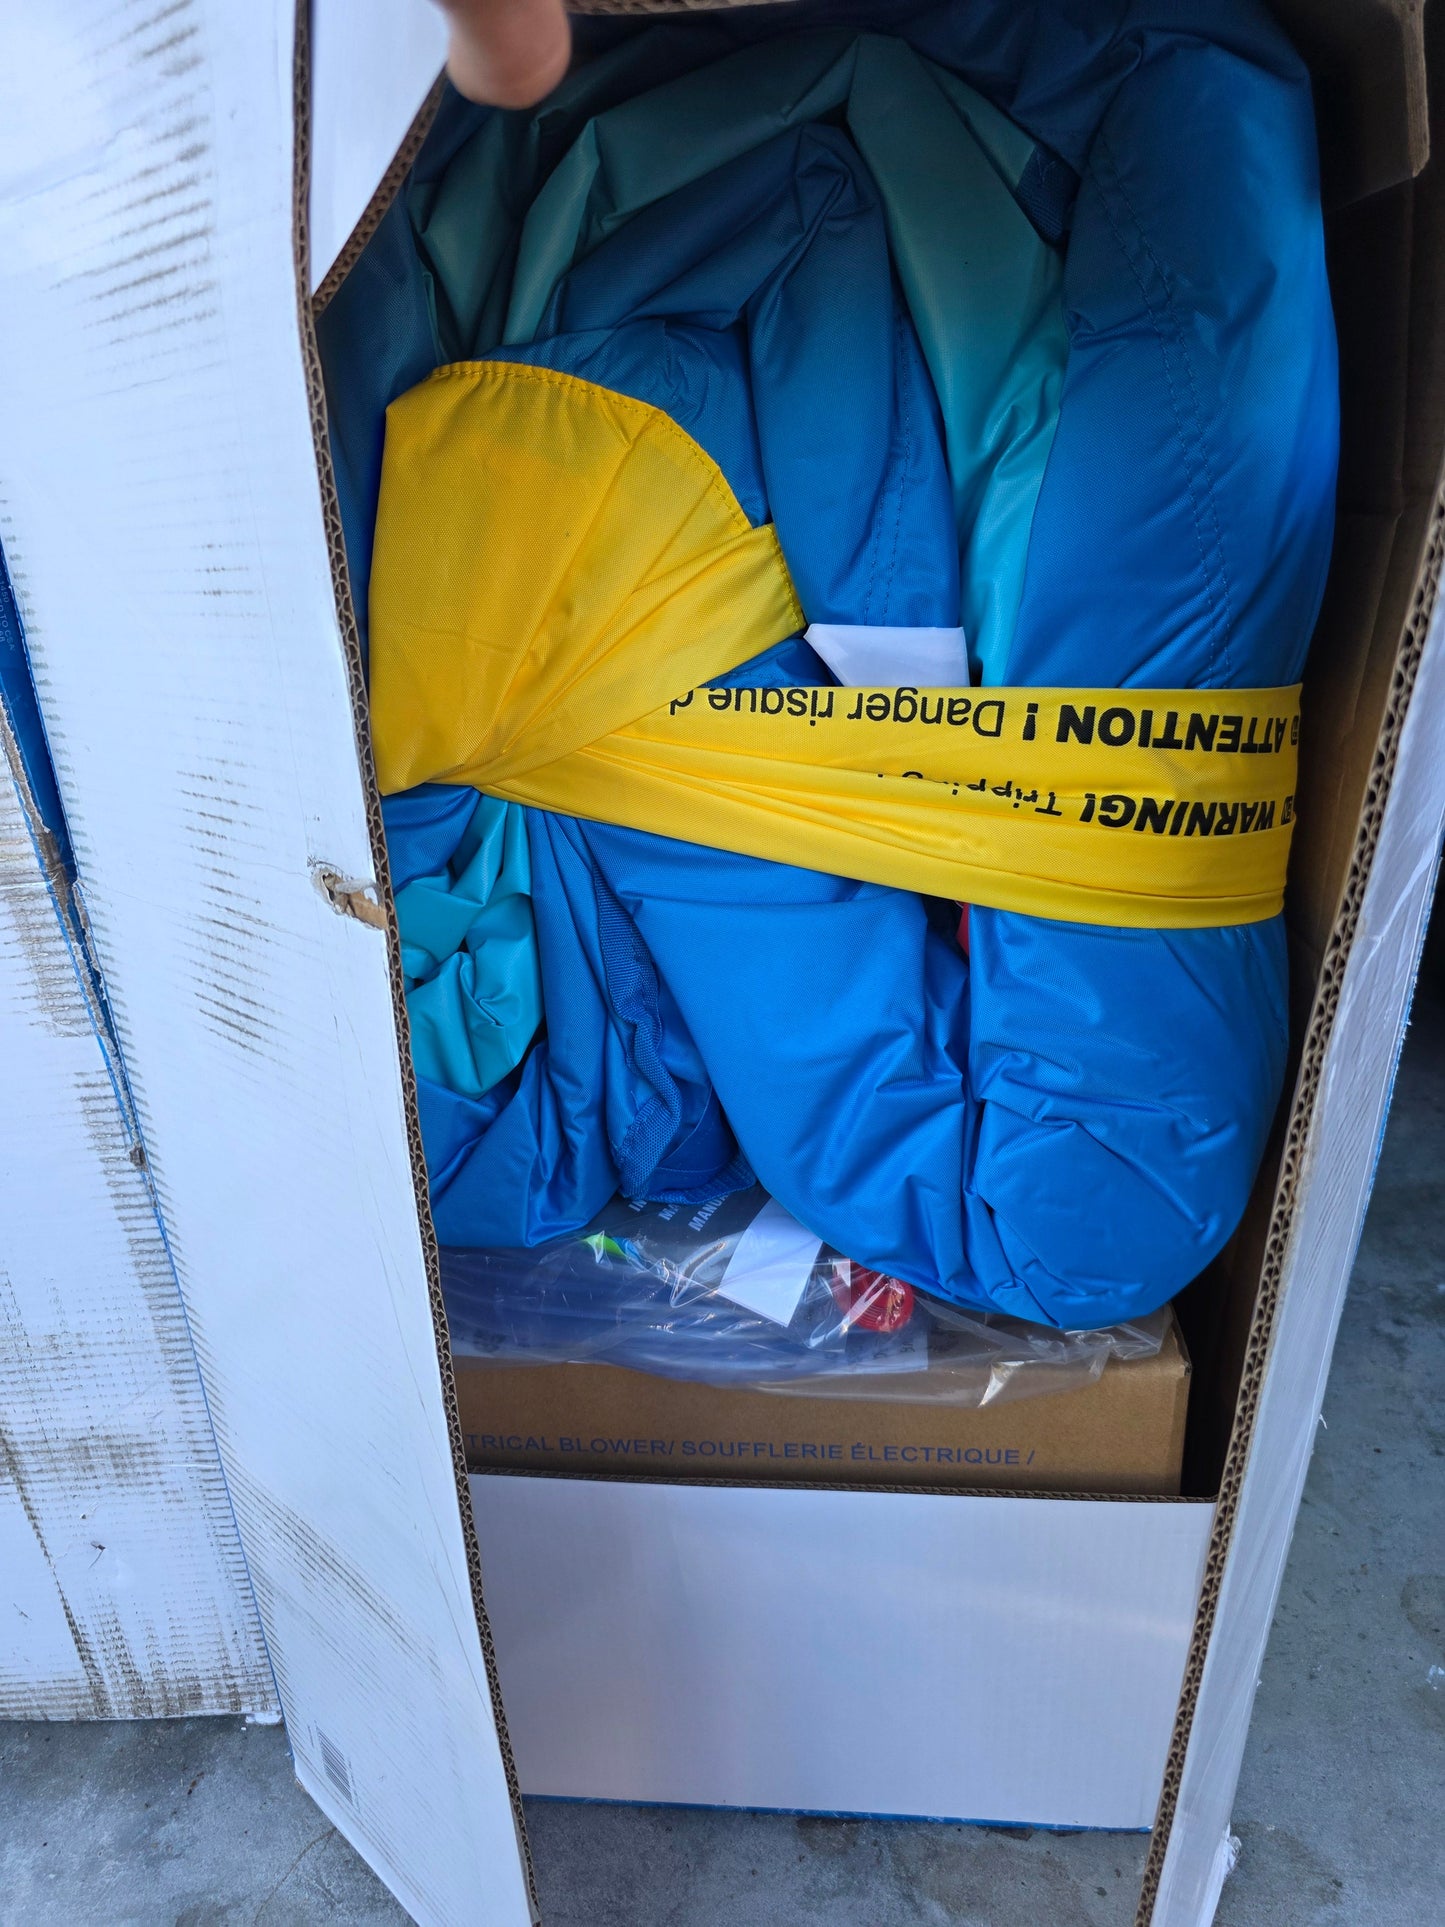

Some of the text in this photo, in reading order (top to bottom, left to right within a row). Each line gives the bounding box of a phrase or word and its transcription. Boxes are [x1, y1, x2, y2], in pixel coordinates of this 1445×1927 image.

[707, 686, 834, 727] risque
[846, 686, 1005, 737] Danger
[1055, 704, 1288, 753] ATTENTION
[1079, 793, 1276, 837] WARNING!
[466, 1434, 554, 1451] TRICAL
[559, 1437, 675, 1456] BLOWER/
[681, 1441, 844, 1460] SOUFFLERIE
[850, 1442, 1021, 1466] ÉLECTRIQUE
